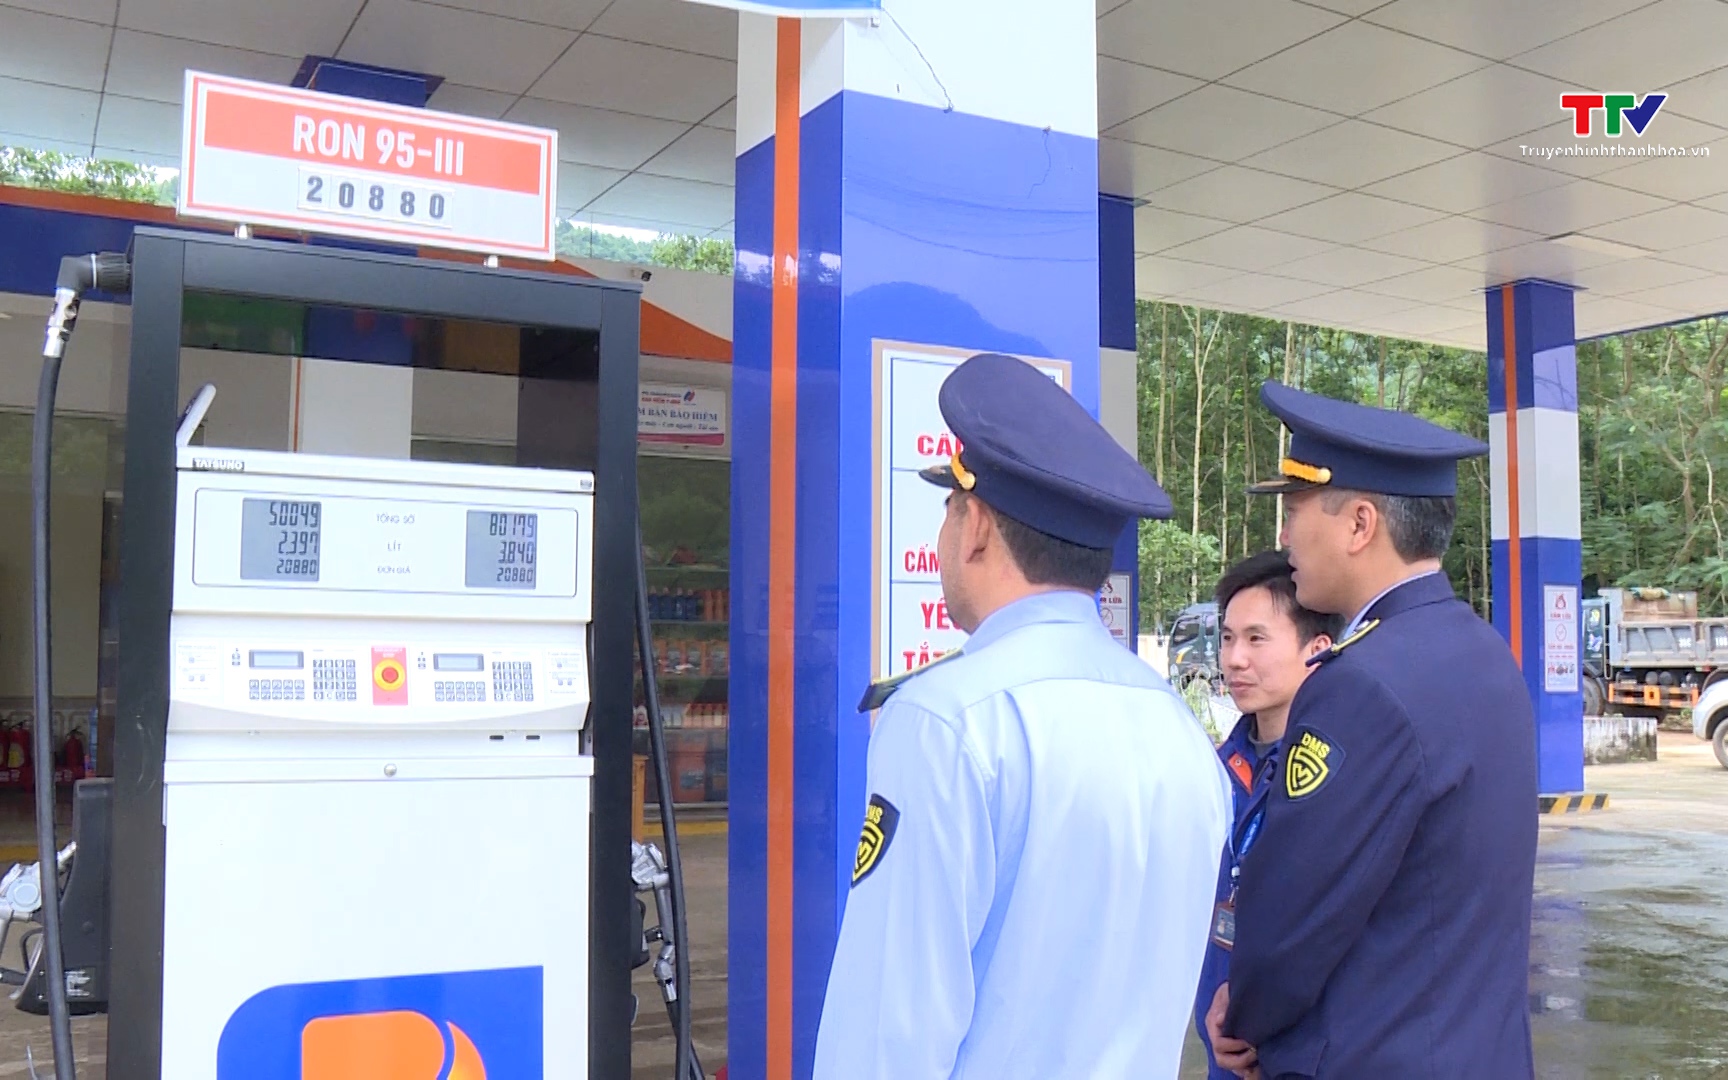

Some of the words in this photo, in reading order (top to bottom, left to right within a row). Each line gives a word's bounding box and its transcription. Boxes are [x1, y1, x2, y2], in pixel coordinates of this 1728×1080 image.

[293, 114, 366, 162] RON
[376, 127, 464, 176] 95-III
[306, 175, 446, 219] 20880
[194, 458, 244, 472] TATSUNO
[268, 501, 320, 527] 50049
[490, 513, 535, 538] 80179
[276, 558, 318, 576] 20880
[496, 567, 534, 583] 20880
[902, 641, 947, 671] TẮ
[1301, 732, 1331, 760] DMS
